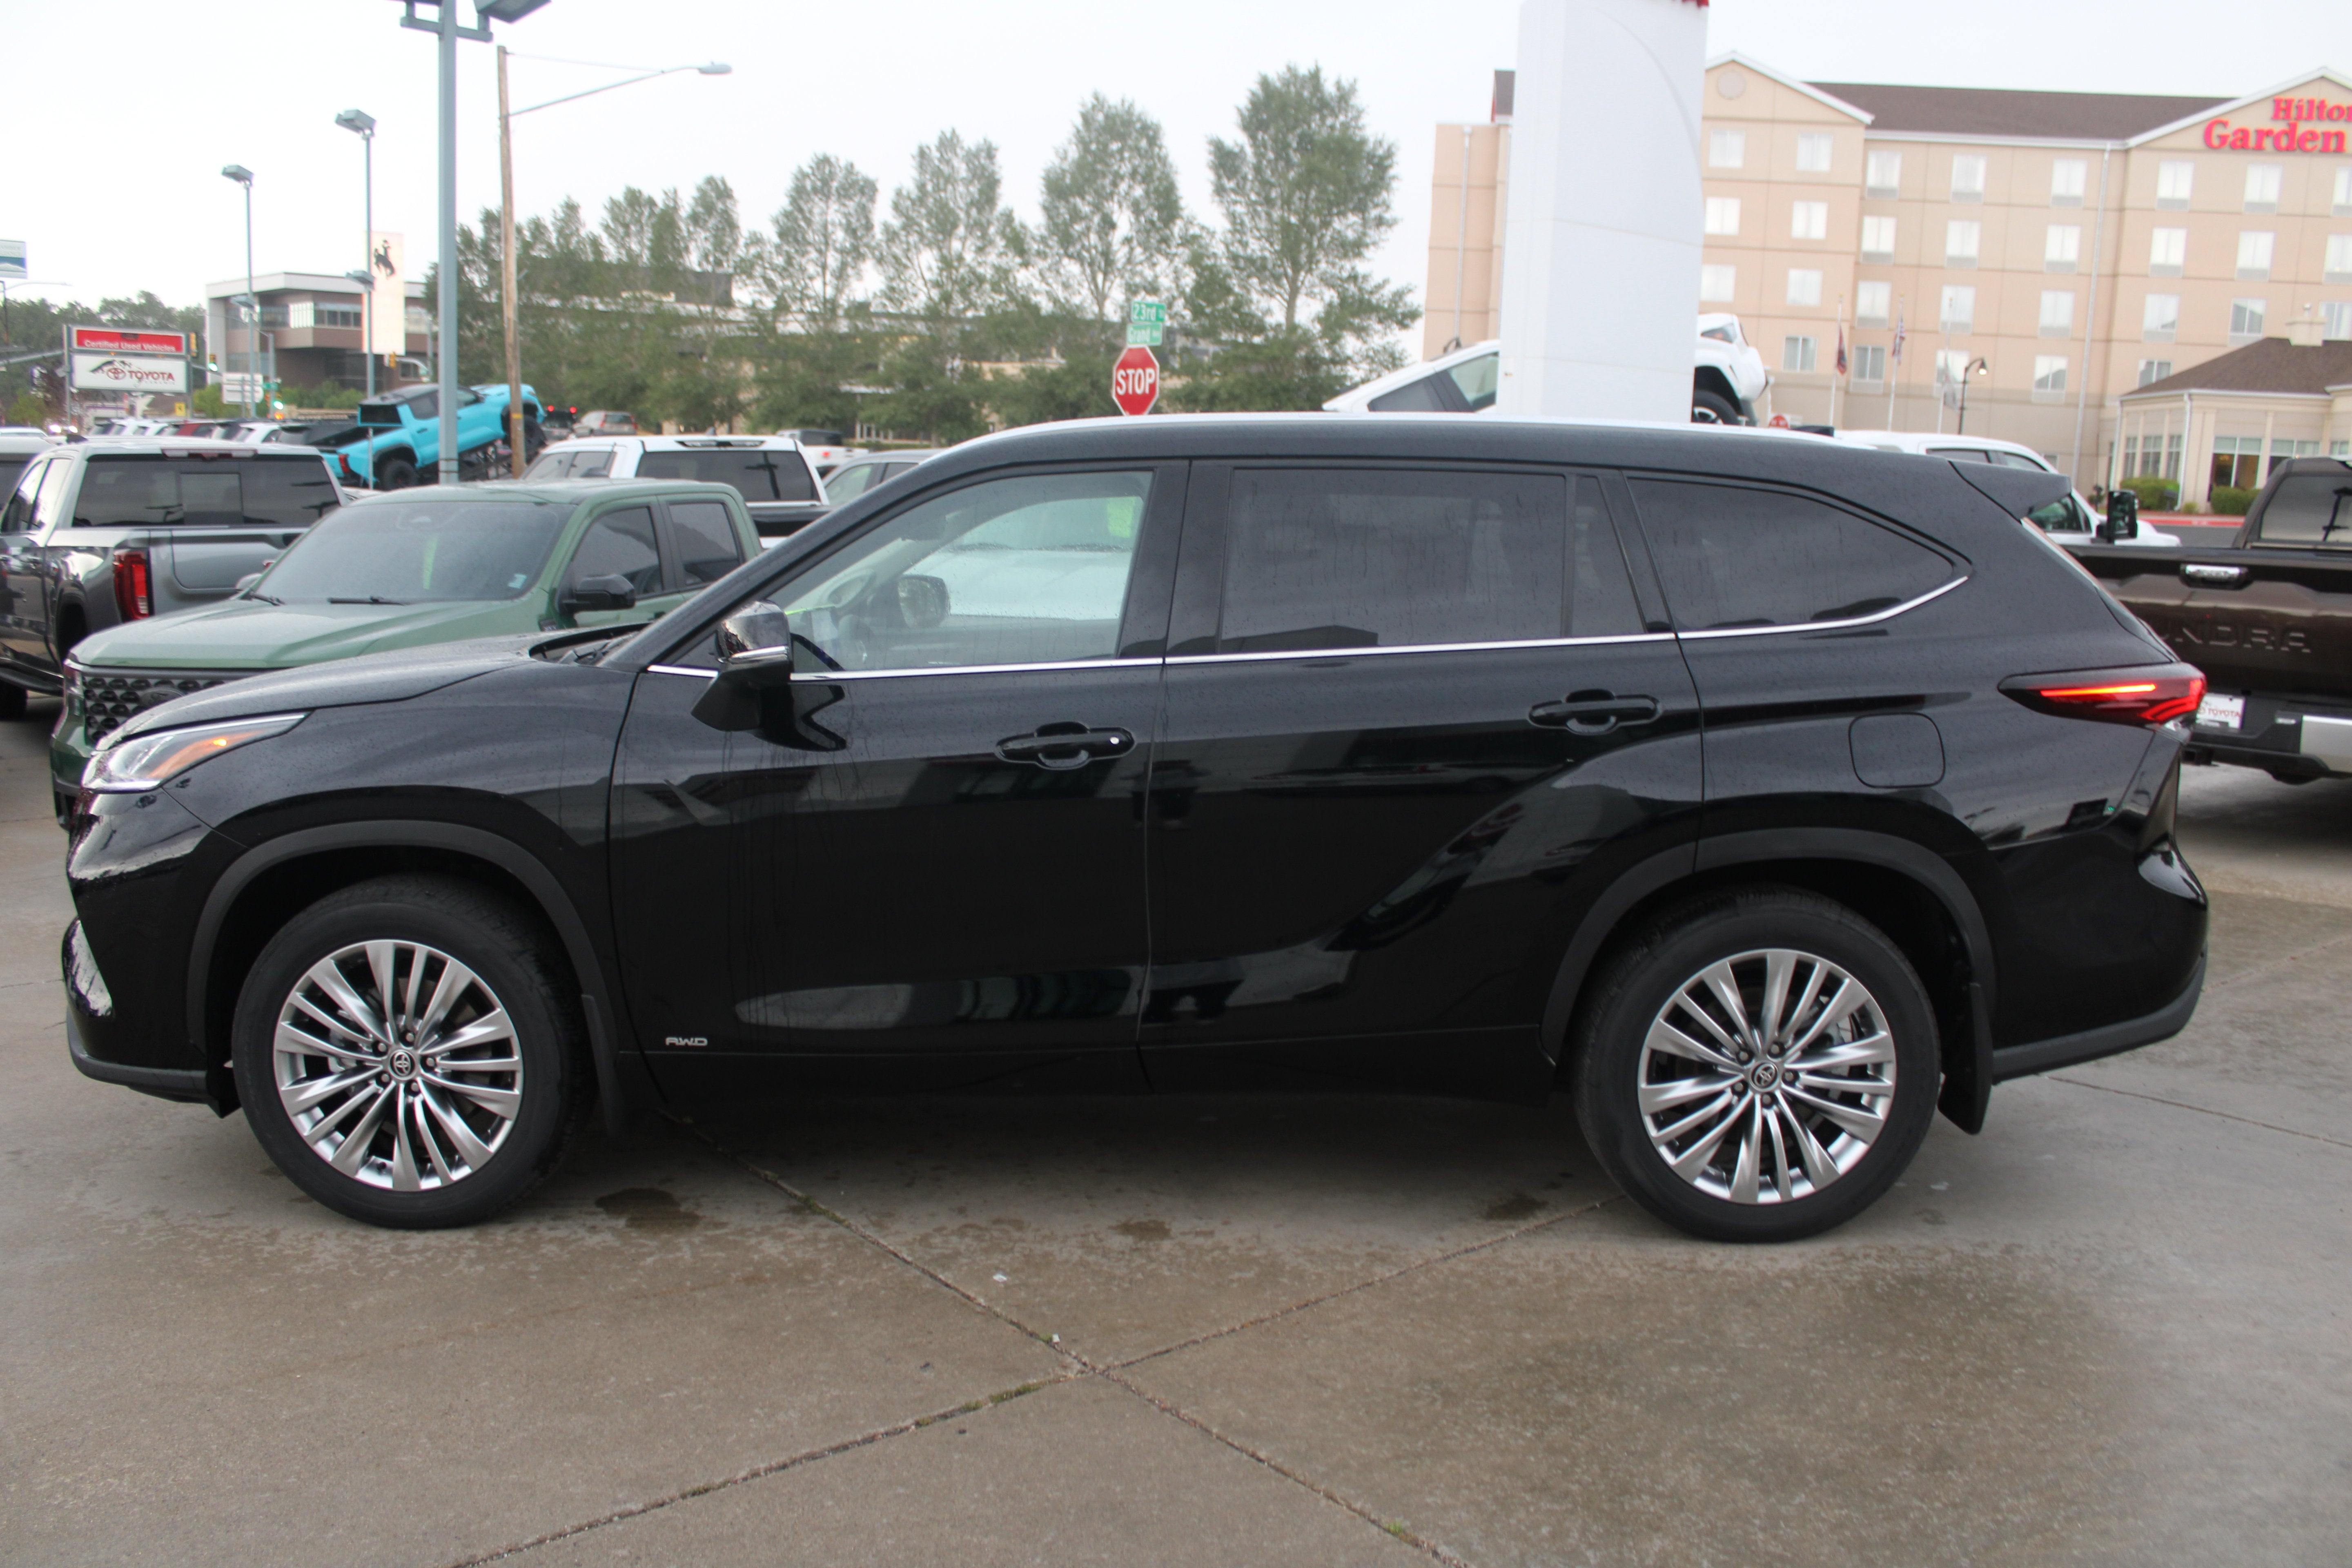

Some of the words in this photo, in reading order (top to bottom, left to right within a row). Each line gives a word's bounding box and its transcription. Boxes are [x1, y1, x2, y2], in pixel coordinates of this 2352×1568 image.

[2204, 118, 2347, 153] Garden
[1133, 303, 1156, 321] 23rd
[84, 339, 119, 349] Certified
[120, 342, 141, 350] Used
[143, 343, 176, 352] Vehicles
[128, 370, 175, 381] TOYOTA
[1116, 368, 1156, 395] STOP
[2207, 708, 2242, 718] TOYOTA
[665, 1037, 708, 1046] AWD
